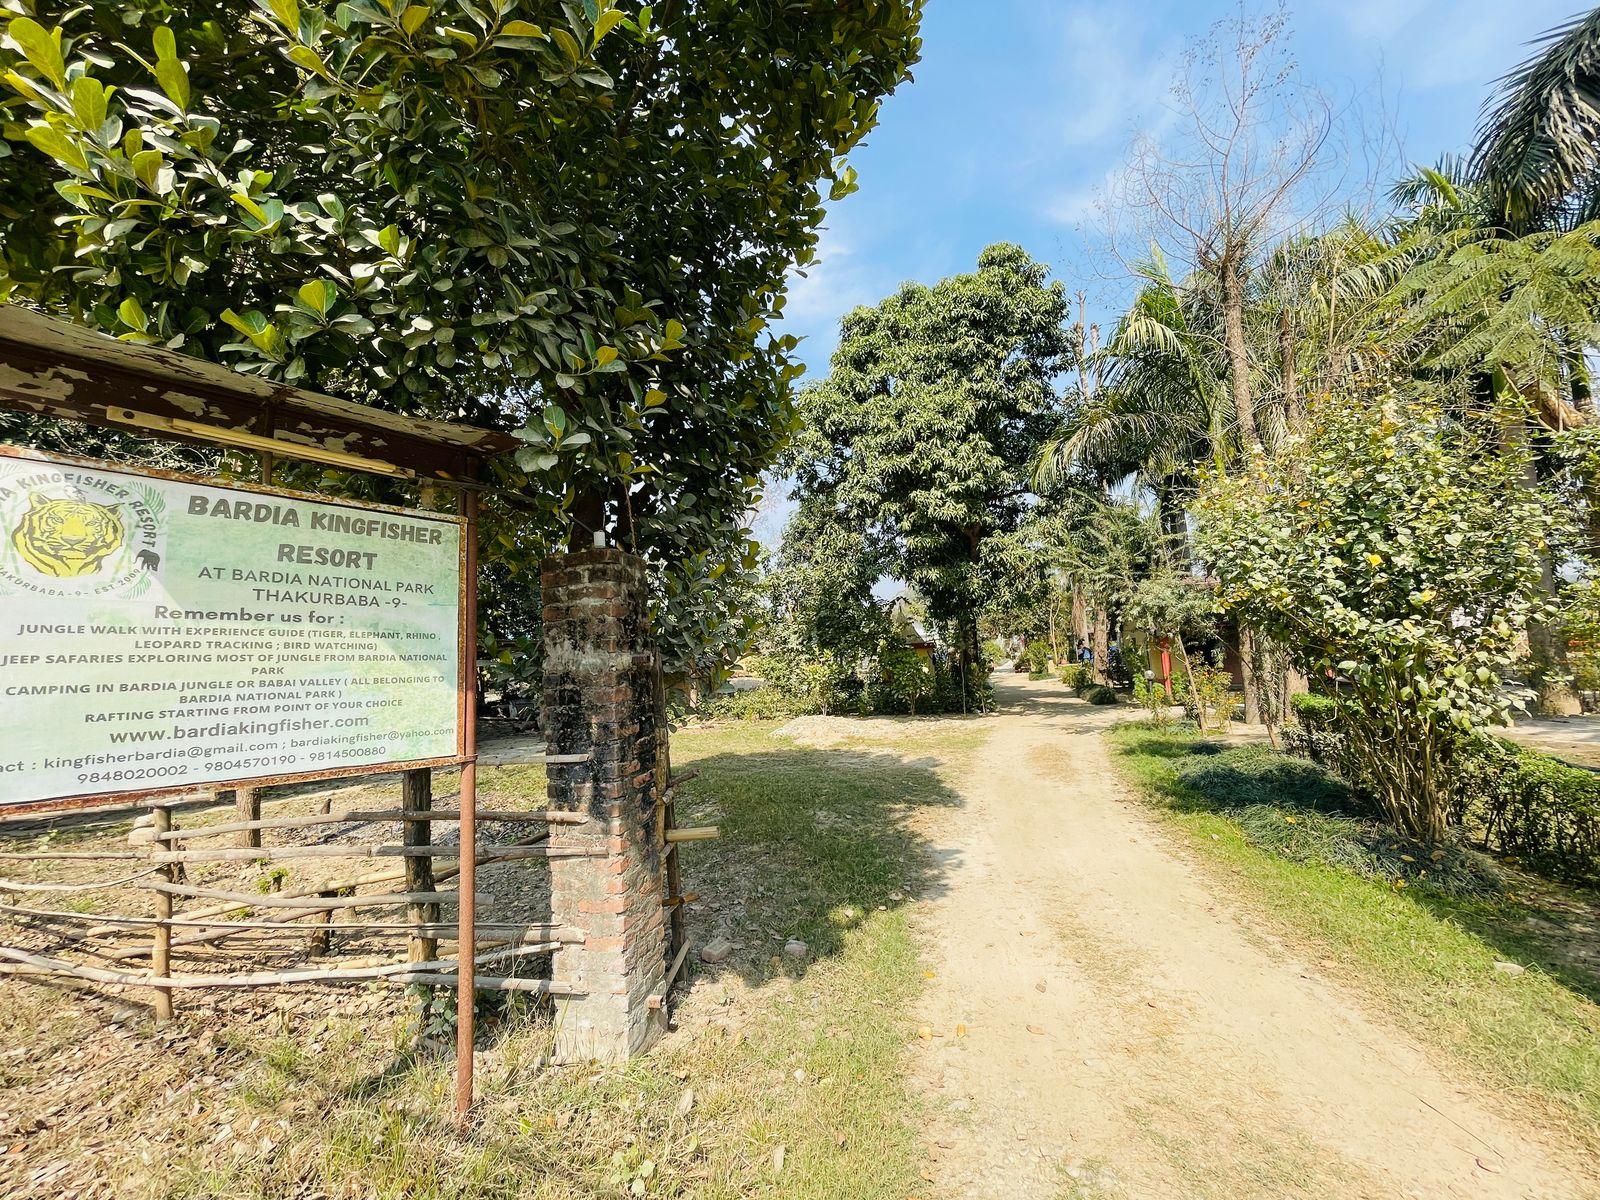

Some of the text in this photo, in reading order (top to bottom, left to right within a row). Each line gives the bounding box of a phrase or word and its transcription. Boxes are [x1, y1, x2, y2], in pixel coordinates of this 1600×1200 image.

[16, 473, 130, 499] KINGFISHER
[128, 500, 157, 547] RESORT
[187, 495, 442, 545] BARDIA KINGFISHER
[277, 543, 378, 570] RESORT
[198, 566, 434, 595] AT BARDIA NATIONAL PARK
[252, 588, 408, 608] THAKURBABA -9-
[154, 605, 275, 622] Remember
[280, 612, 302, 623] us
[308, 611, 334, 624] for
[17, 624, 86, 636] JUNGLE
[90, 625, 138, 635] WALK
[141, 626, 181, 636] WITH
[185, 627, 265, 637] EXPERIENCE
[268, 629, 305, 638] GUIDE
[307, 630, 346, 640] (TIGER,
[349, 631, 404, 641] ELEPHANT,
[406, 632, 436, 640] RHINO
[134, 640, 202, 650] LEOPARD
[206, 641, 273, 650] TRACKING
[283, 642, 311, 651] BIRD
[314, 642, 378, 651] WATCHING)
[0, 655, 40, 667] JEEP
[45, 654, 123, 664] SAFARIES
[127, 654, 213, 664] EXPLORING
[216, 654, 254, 664] MOST
[257, 654, 274, 663] OF
[275, 654, 321, 664] JUNGLE
[358, 654, 397, 662] BARDIA
[399, 654, 448, 662] NATIONAL
[251, 667, 285, 676] PARK
[5, 684, 91, 696] CAMPING
[96, 684, 114, 693] IN
[119, 682, 177, 692] BARDIA
[179, 681, 233, 692] JUNGLE
[236, 681, 255, 689] OR
[258, 679, 297, 688] BABAI
[299, 678, 341, 686] VALLEY
[350, 677, 371, 686] ALL
[372, 676, 431, 685] BELONGING
[432, 675, 445, 683] TO
[179, 694, 231, 704] BARDIA
[236, 692, 302, 701] NATIONAL
[305, 690, 336, 699] PARK
[84, 699, 403, 722] RAFTING STARTING FROM POINT OF YOUR CHOICE
[109, 715, 369, 744] www.bardiakingfisher.com
[44, 741, 278, 769] kingfisherbardia@gmail.com
[290, 727, 455, 748] bardiakingfisher@yahoo.com
[77, 764, 188, 784] 9848020002
[204, 754, 296, 772] 9804570190
[309, 746, 387, 762] 9814500880
